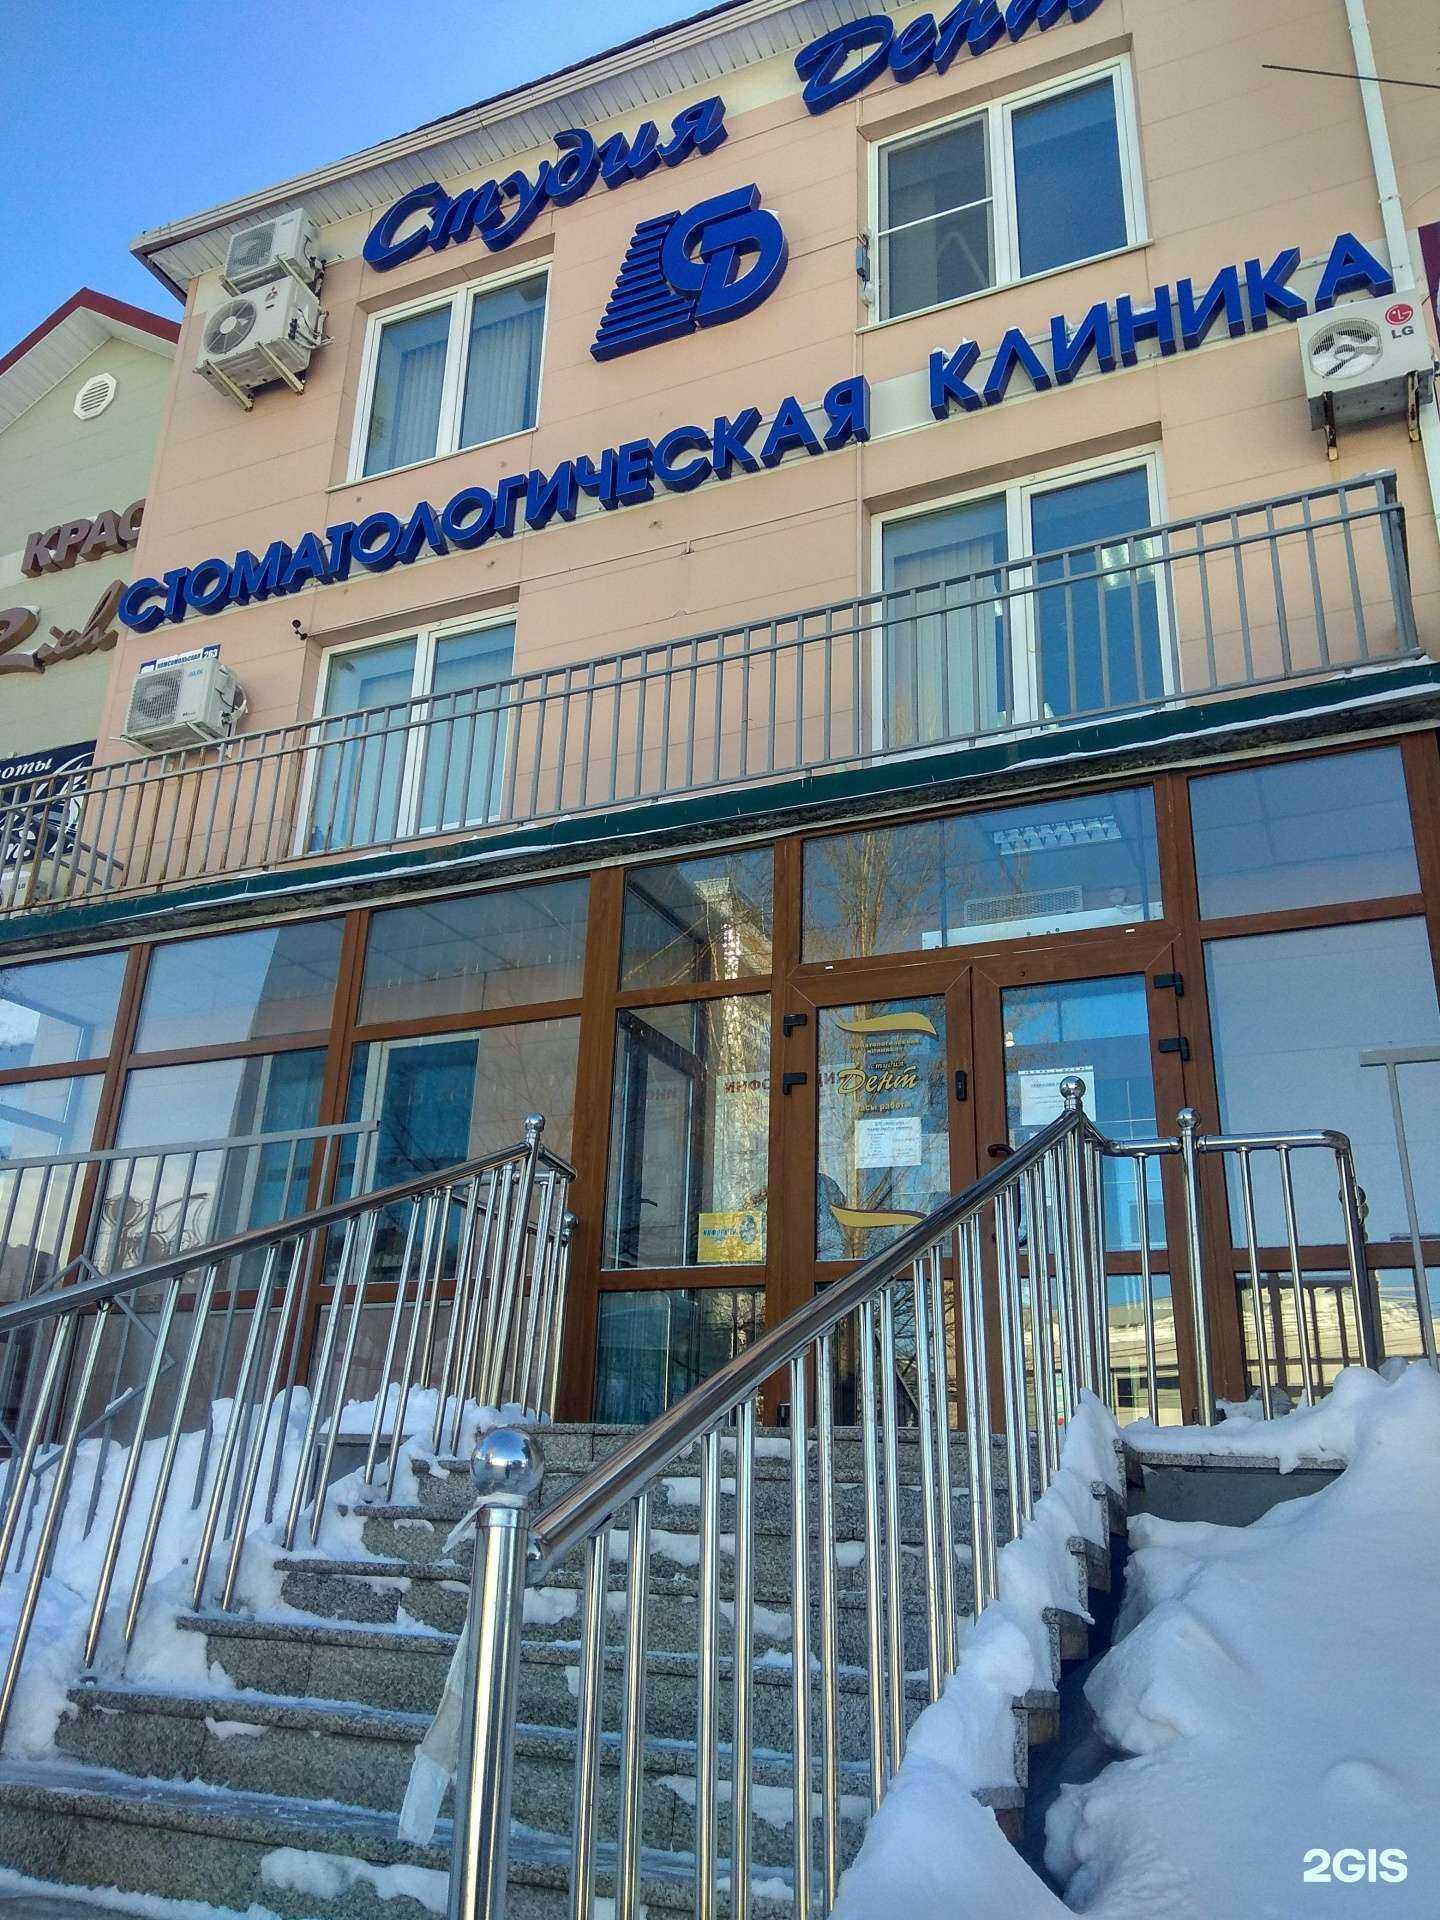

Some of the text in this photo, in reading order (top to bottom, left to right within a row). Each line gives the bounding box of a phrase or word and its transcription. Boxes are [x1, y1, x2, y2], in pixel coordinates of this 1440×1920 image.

[362, 95, 729, 272] Студия
[1391, 325, 1415, 339] LG
[118, 231, 1394, 633] СТОМАТОЛОГИЧЕСКАЯ КЛИНИКА
[0, 757, 53, 779] оты
[837, 1065, 918, 1095] Дент
